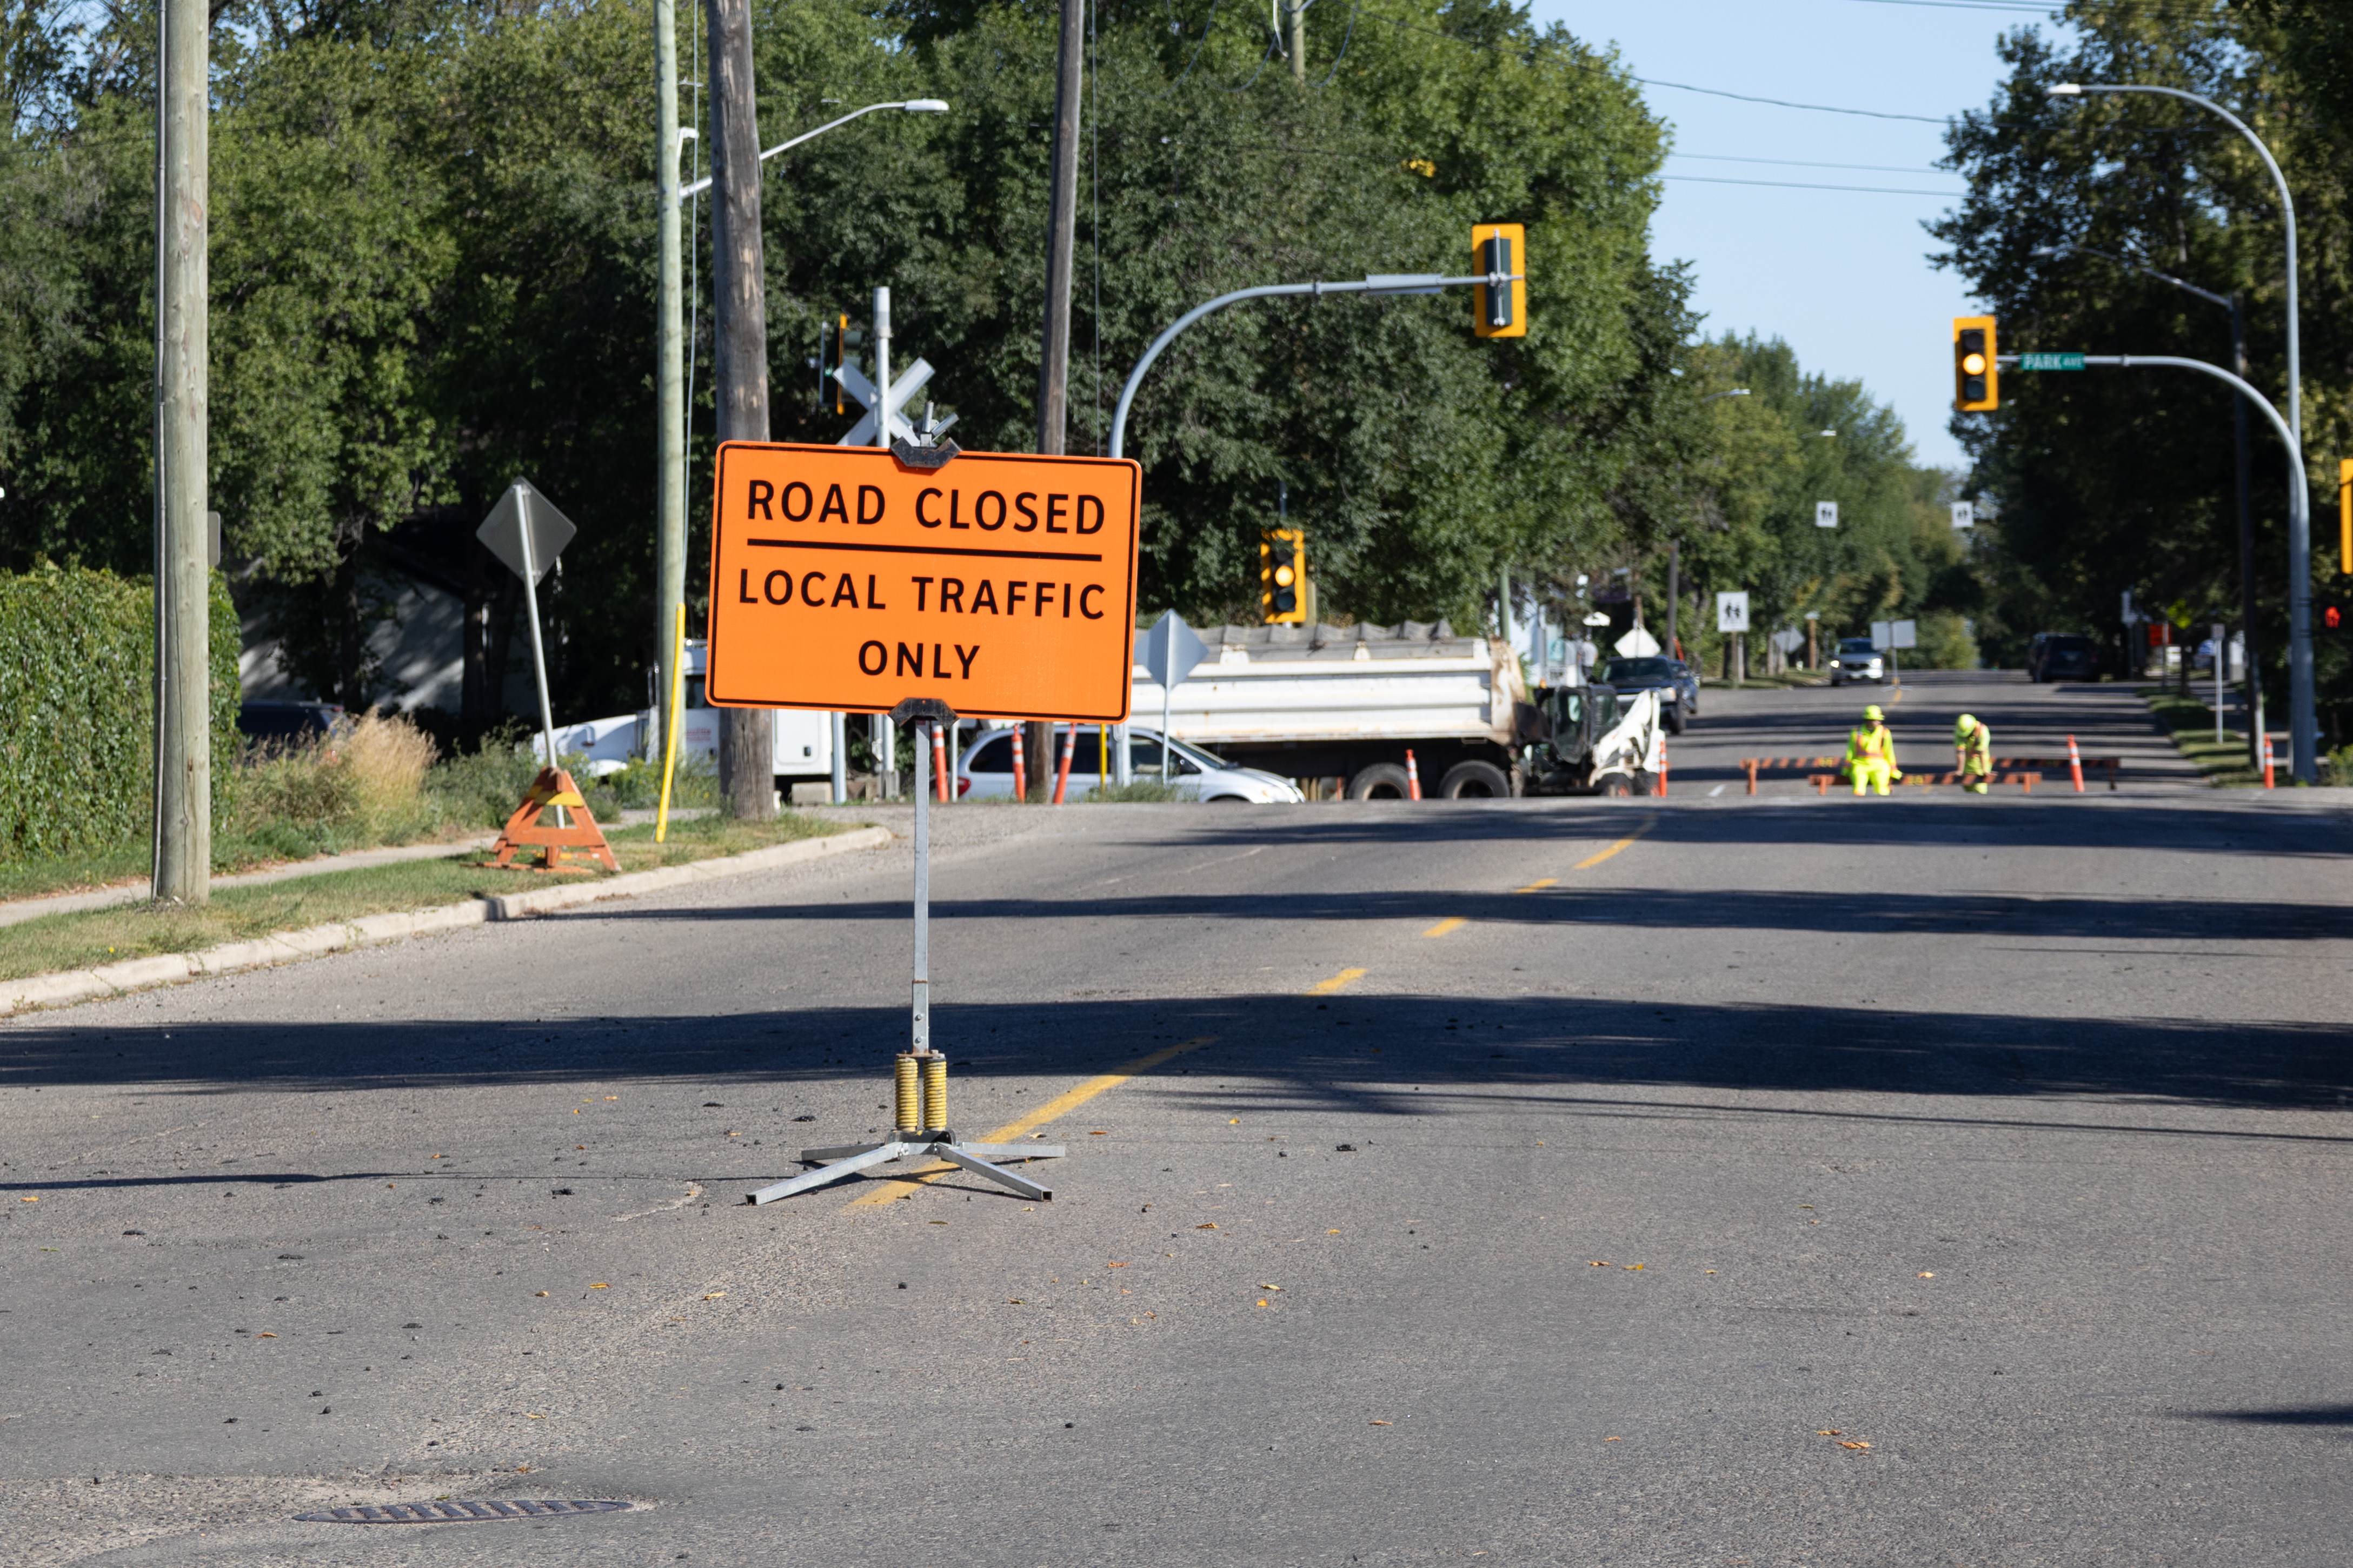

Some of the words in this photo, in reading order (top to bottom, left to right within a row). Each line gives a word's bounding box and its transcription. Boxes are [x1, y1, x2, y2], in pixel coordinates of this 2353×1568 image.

[2023, 354, 2062, 370] PARK
[2063, 357, 2083, 367] AVE
[748, 480, 885, 524] ROAD
[915, 488, 1105, 535] CLOSED
[740, 569, 886, 609] LOCAL
[912, 576, 1105, 619] TRAFFIC
[859, 640, 980, 679] ONLY
